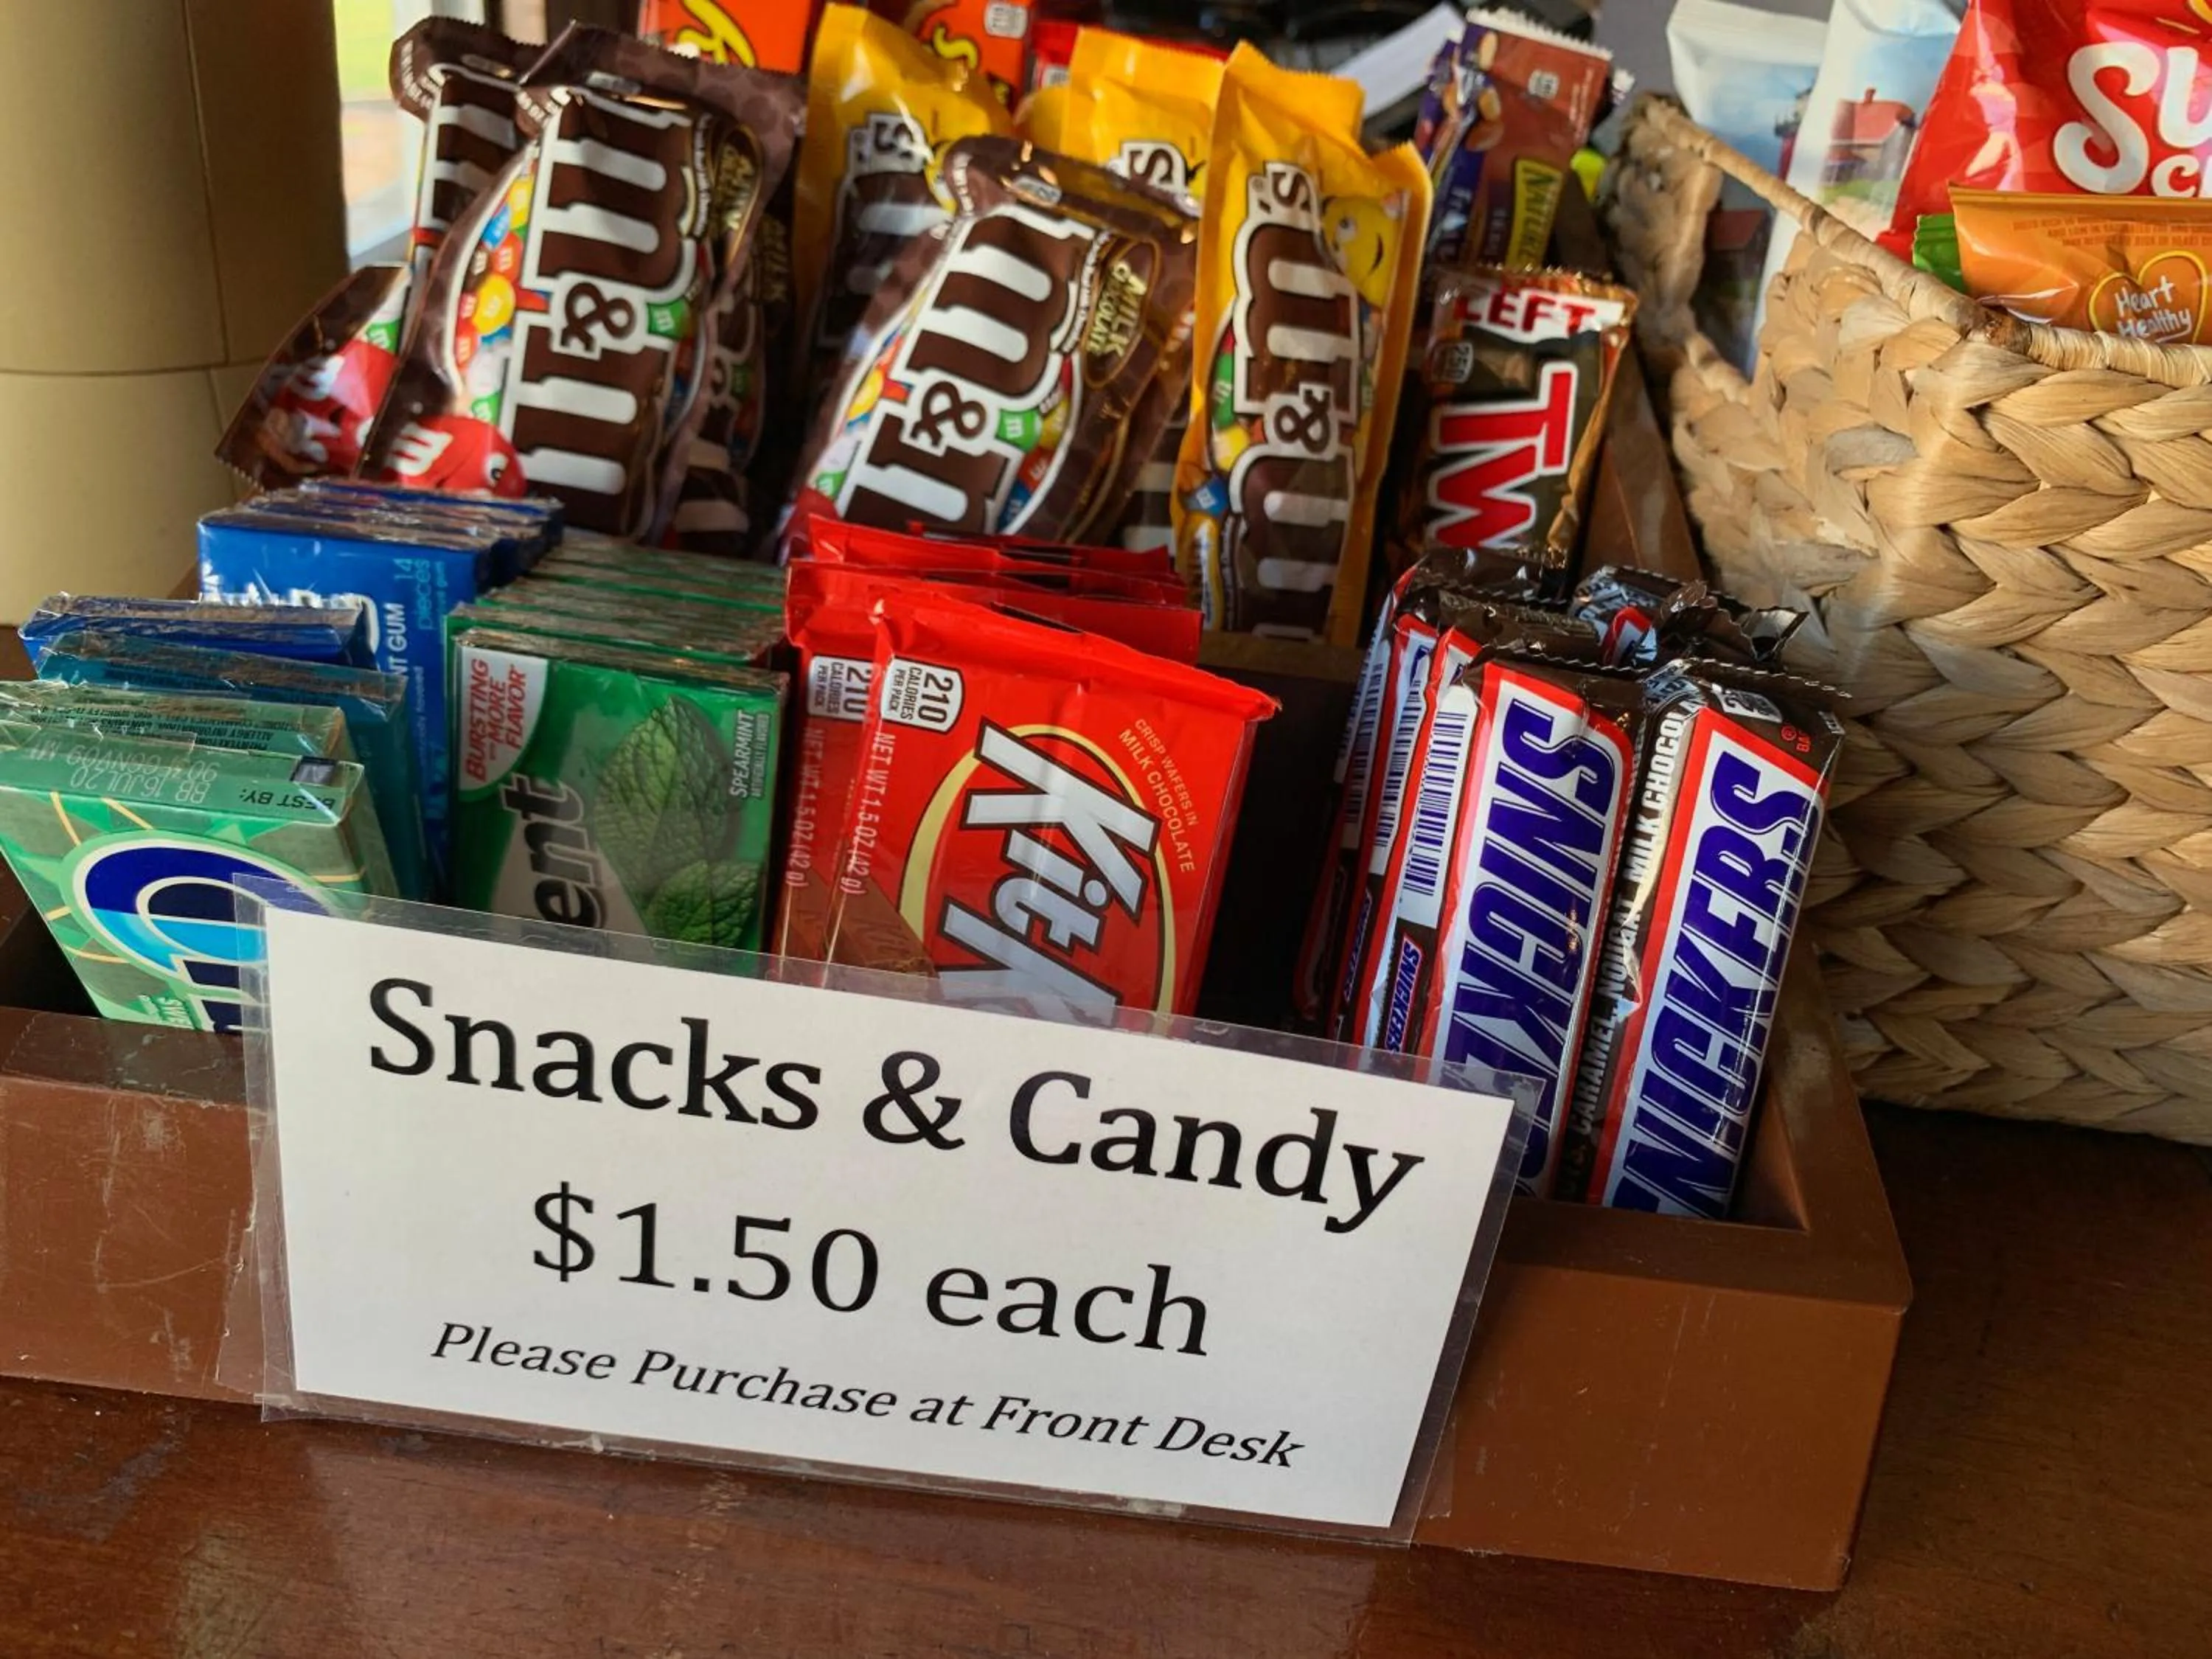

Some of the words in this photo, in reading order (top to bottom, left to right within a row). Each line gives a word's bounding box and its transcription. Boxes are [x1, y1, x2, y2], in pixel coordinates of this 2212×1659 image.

[1105, 274, 1148, 358] MILK
[1453, 291, 1598, 336] LEFT
[2115, 275, 2174, 318] Heart
[2116, 307, 2194, 344] Healthy
[394, 558, 415, 580] 14
[415, 559, 434, 630] pieces
[383, 602, 408, 652] GUM
[813, 685, 827, 709] PACK
[818, 664, 830, 686] PER
[826, 661, 846, 716] CALORIES
[843, 667, 874, 716] 210
[893, 668, 907, 693] PER
[900, 665, 923, 721] CALORIES
[917, 672, 954, 725] 210
[465, 658, 490, 782] BURSTING
[487, 675, 506, 745] MORE
[505, 665, 526, 750] FLAVOR
[889, 691, 905, 712] PACK
[728, 709, 757, 799] SPEARMINT
[870, 731, 896, 765] NET
[1134, 717, 1166, 755] CRISP
[1161, 754, 1193, 810] WAFERS
[1185, 810, 1199, 827] IN
[175, 781, 212, 805] BB
[240, 788, 274, 807] BY:
[276, 793, 337, 810] BEST
[863, 769, 888, 794] WT
[1119, 728, 1155, 771] MILK
[1147, 770, 1196, 874] CHOCOLATE
[858, 797, 883, 823] 1.5
[852, 824, 877, 849] OZ
[961, 723, 1161, 953] Kit
[1624, 816, 1658, 883] MILK
[1385, 938, 1420, 1053] SNICKERS
[369, 977, 821, 1131] Snacks
[863, 1050, 965, 1150] &
[1009, 1071, 1425, 1233] Candy
[533, 1181, 878, 1312] $1.50
[926, 1264, 1208, 1356] each
[431, 1322, 616, 1380] Please
[631, 1349, 897, 1424] Purchase
[911, 1394, 973, 1427] at
[981, 1396, 1147, 1446] Front
[1155, 1416, 1304, 1467] Desk
